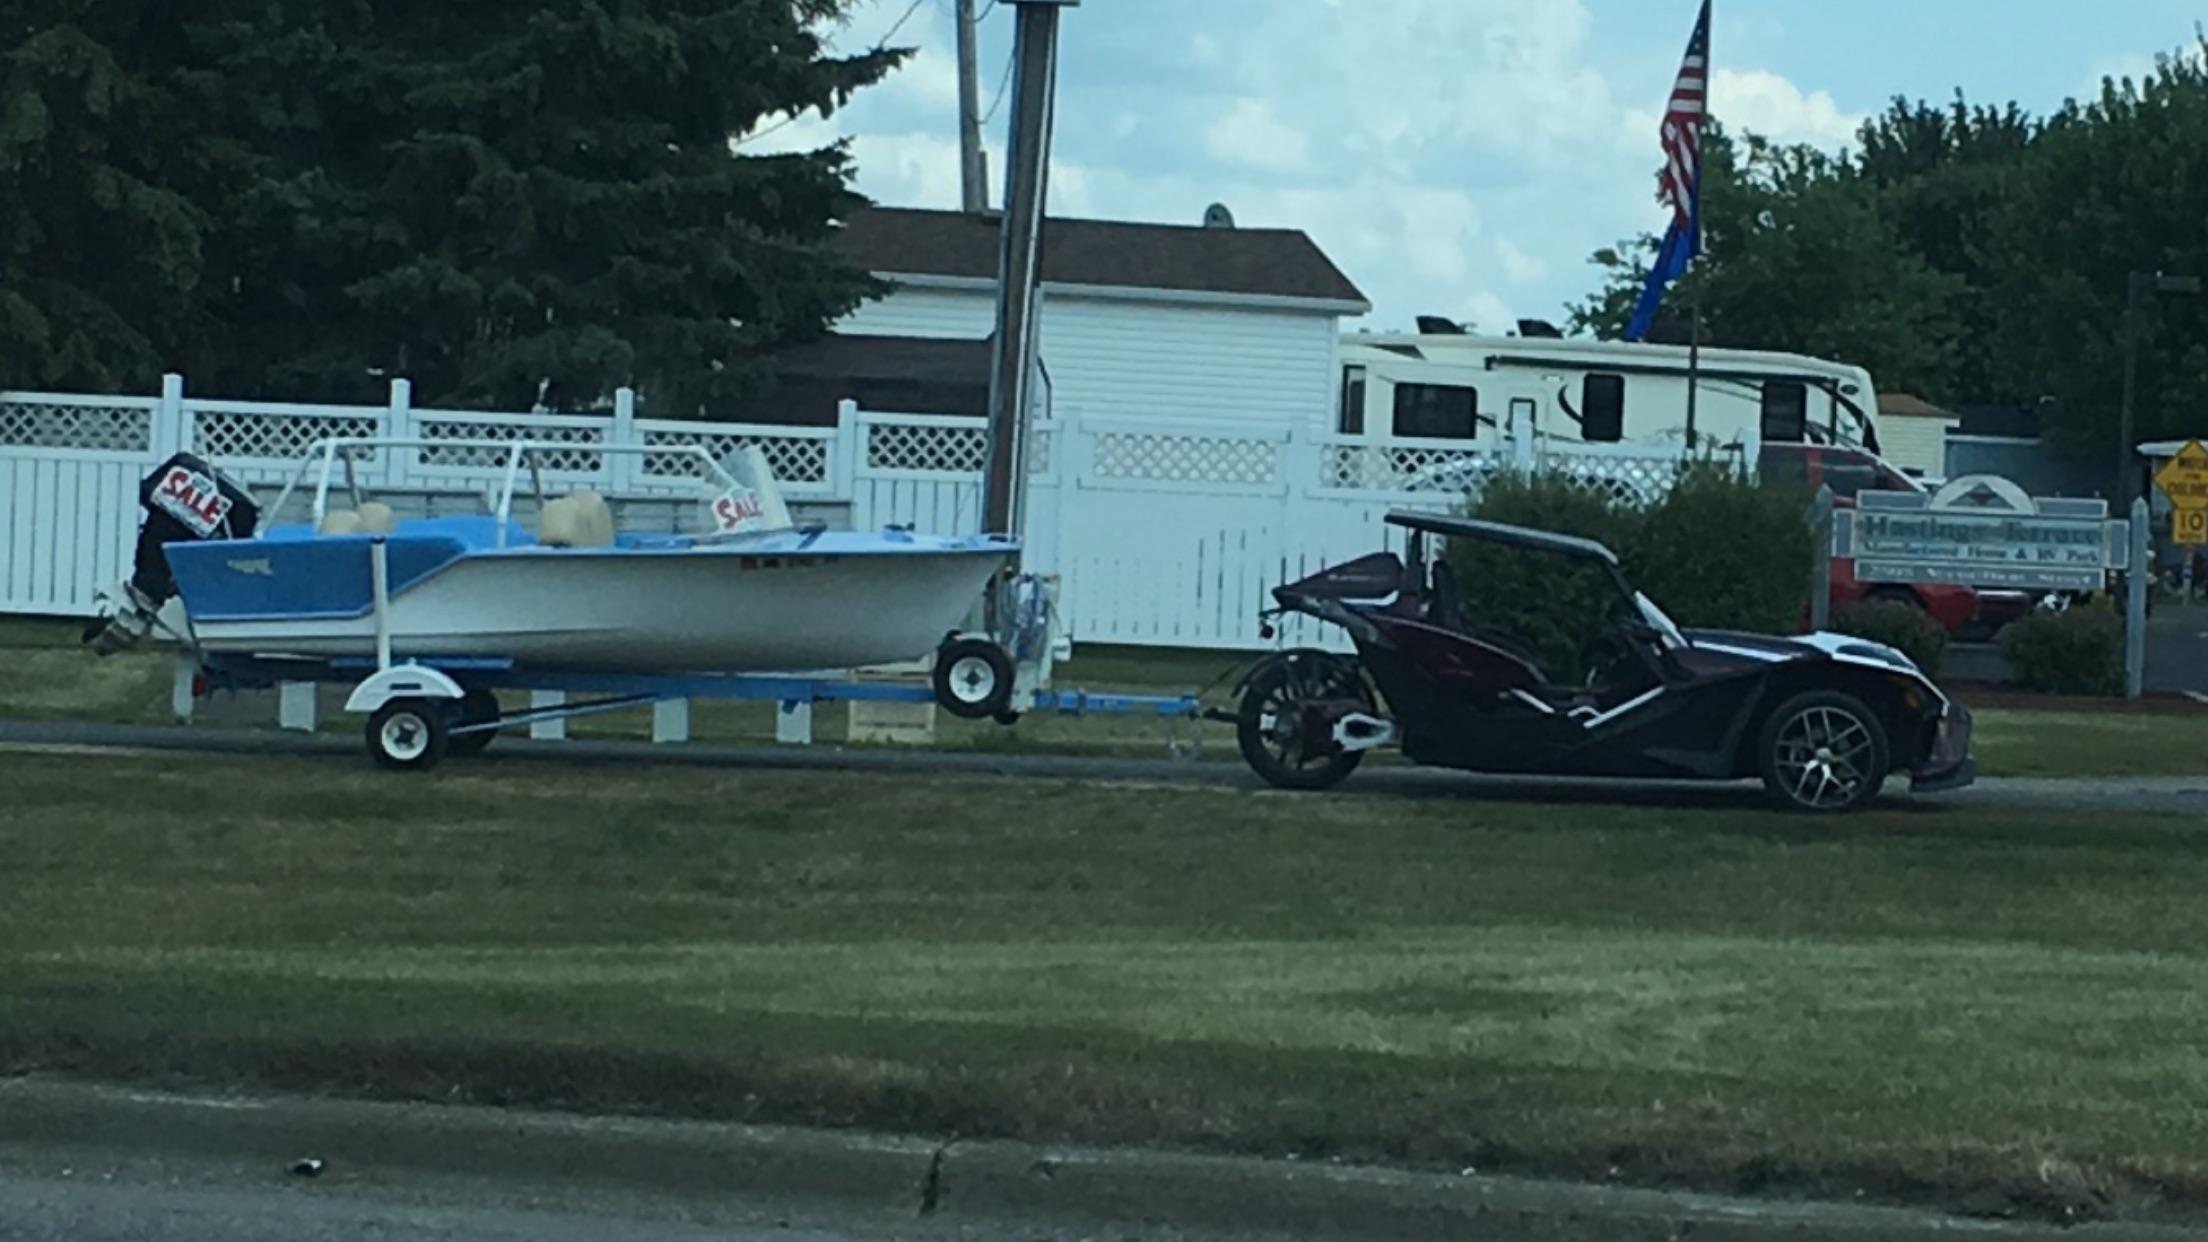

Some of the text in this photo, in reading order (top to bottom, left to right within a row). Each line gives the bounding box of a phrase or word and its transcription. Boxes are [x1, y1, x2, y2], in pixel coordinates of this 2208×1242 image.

[162, 471, 221, 525] SALE
[717, 491, 763, 529] SALE
[2181, 512, 2204, 531] 10
